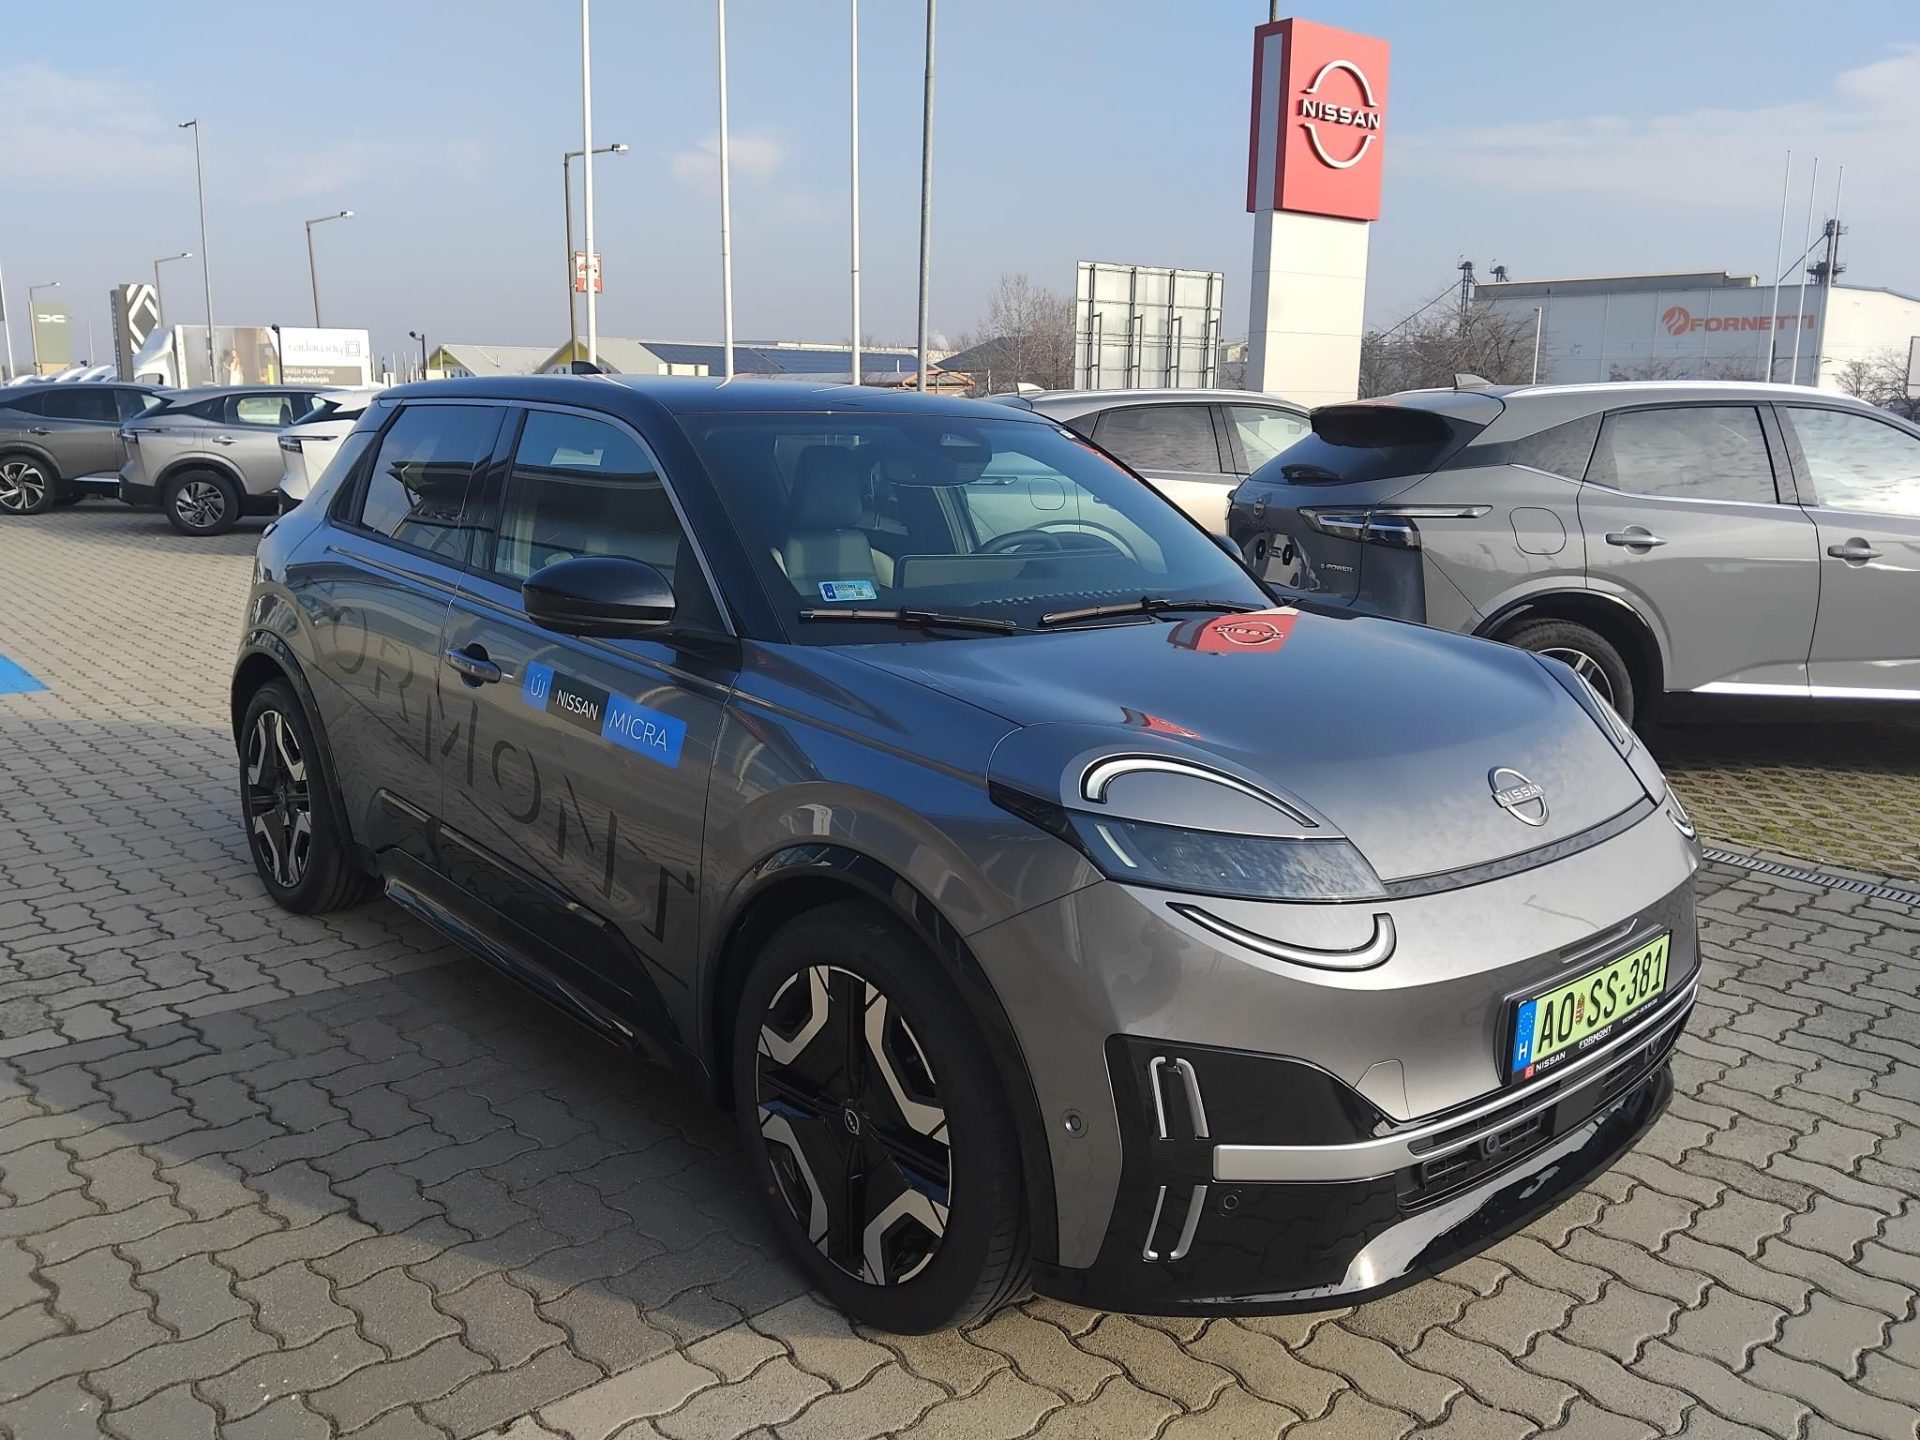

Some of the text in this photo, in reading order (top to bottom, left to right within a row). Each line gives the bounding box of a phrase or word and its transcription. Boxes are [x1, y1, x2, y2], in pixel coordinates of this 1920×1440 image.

[1302, 98, 1380, 129] NISSAN
[1689, 315, 1815, 332] FORNETTI
[530, 673, 668, 752] ÚJ NISSAN MICRA
[1497, 784, 1544, 805] NISSAN
[1518, 1041, 1528, 1061] H
[1538, 991, 1575, 1053] AO
[1535, 1051, 1566, 1072] NISSAN
